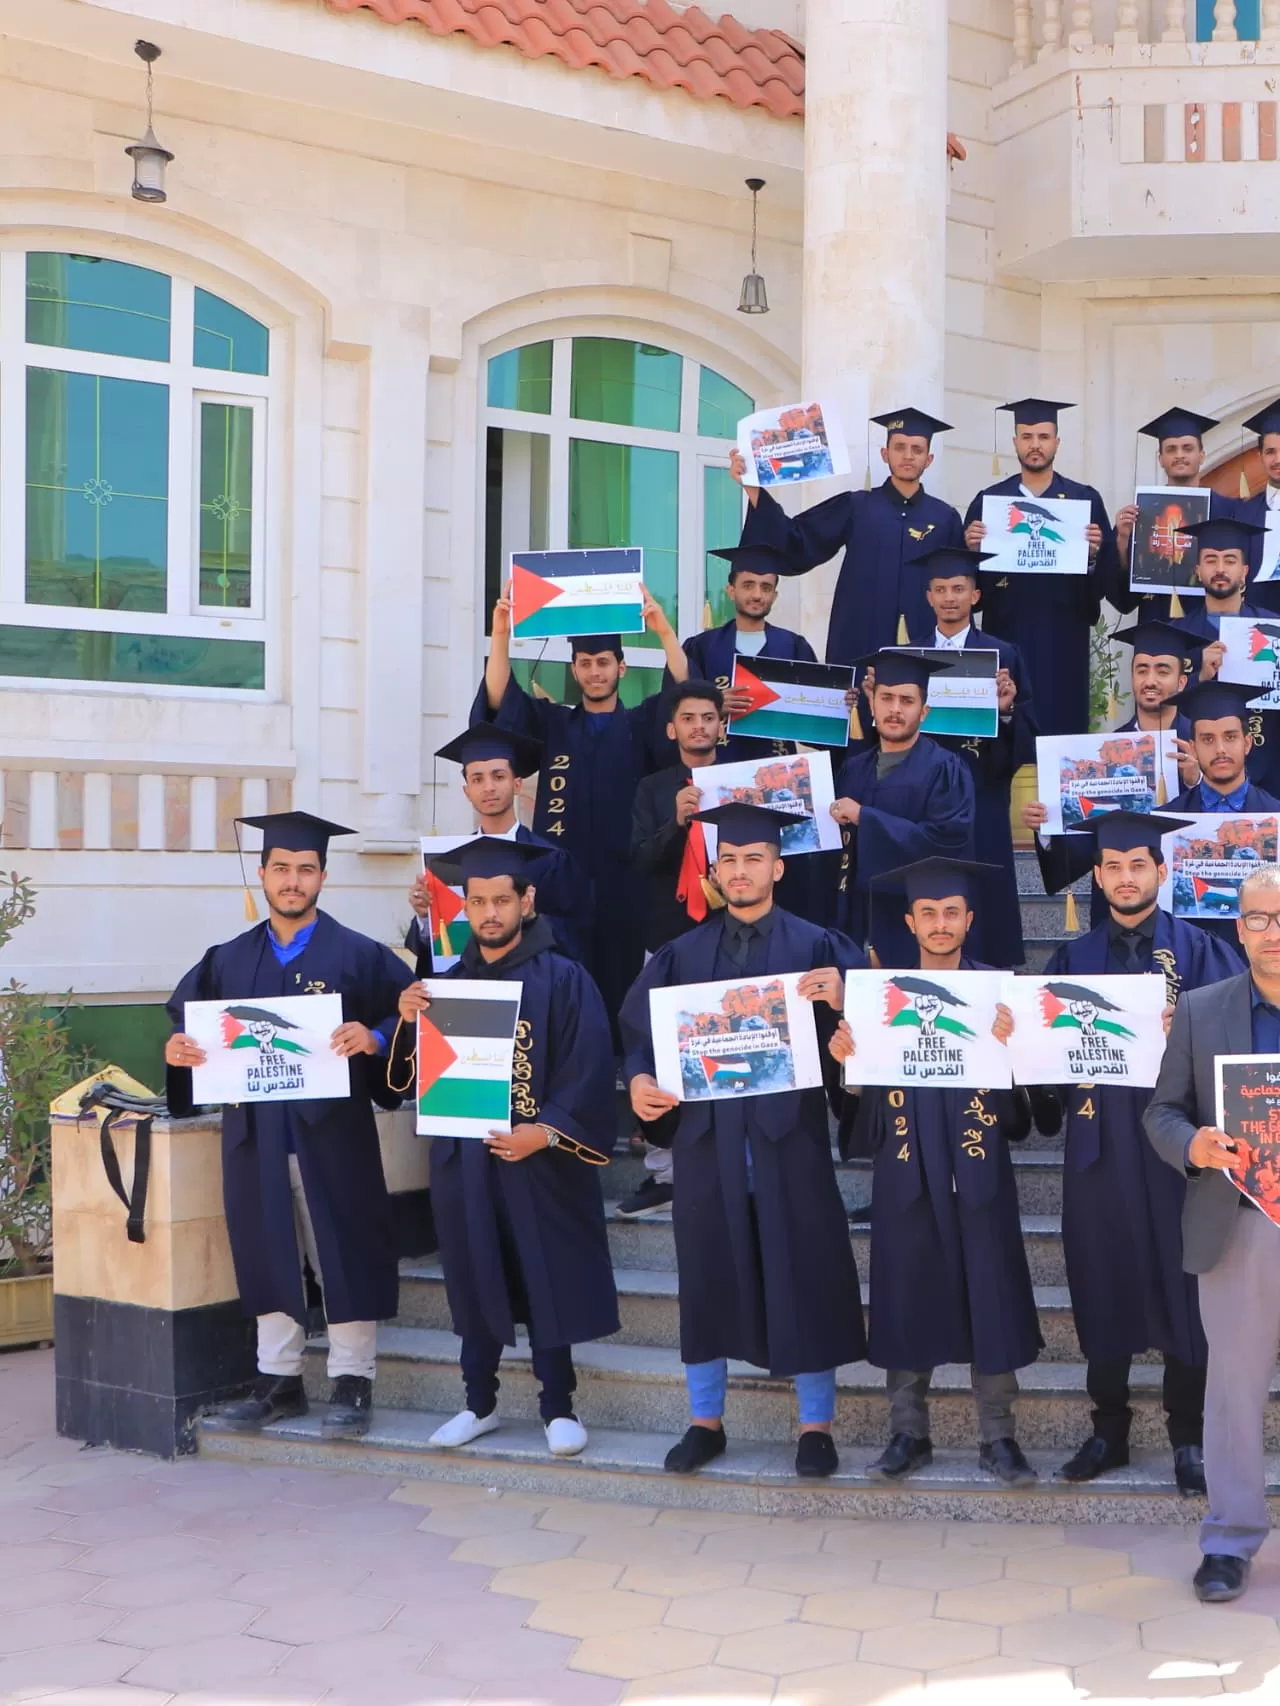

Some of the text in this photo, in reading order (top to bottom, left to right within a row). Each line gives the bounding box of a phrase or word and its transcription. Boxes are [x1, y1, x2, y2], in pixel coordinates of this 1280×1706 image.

[1028, 542, 1046, 550] FREE
[1018, 550, 1056, 558] PALESTINE
[1028, 560, 1056, 568] القدس
[546, 754, 570, 836] 2024
[838, 831, 851, 892] 024
[918, 1036, 946, 1048] FREE
[1080, 1036, 1109, 1048] FREE
[722, 1044, 752, 1054] genocide
[904, 1049, 963, 1062] PALESTINE
[1068, 1049, 1126, 1062] PALESTINE
[260, 1054, 286, 1065] FREE
[248, 1064, 303, 1079] PALESTINE
[904, 1064, 964, 1079] القدس لنا
[1070, 1062, 1128, 1076] القدس لنا
[248, 1078, 304, 1093] القدس لنا
[888, 1090, 911, 1162] 024
[1240, 1120, 1266, 1134] THE
[1260, 1132, 1272, 1144] IN
